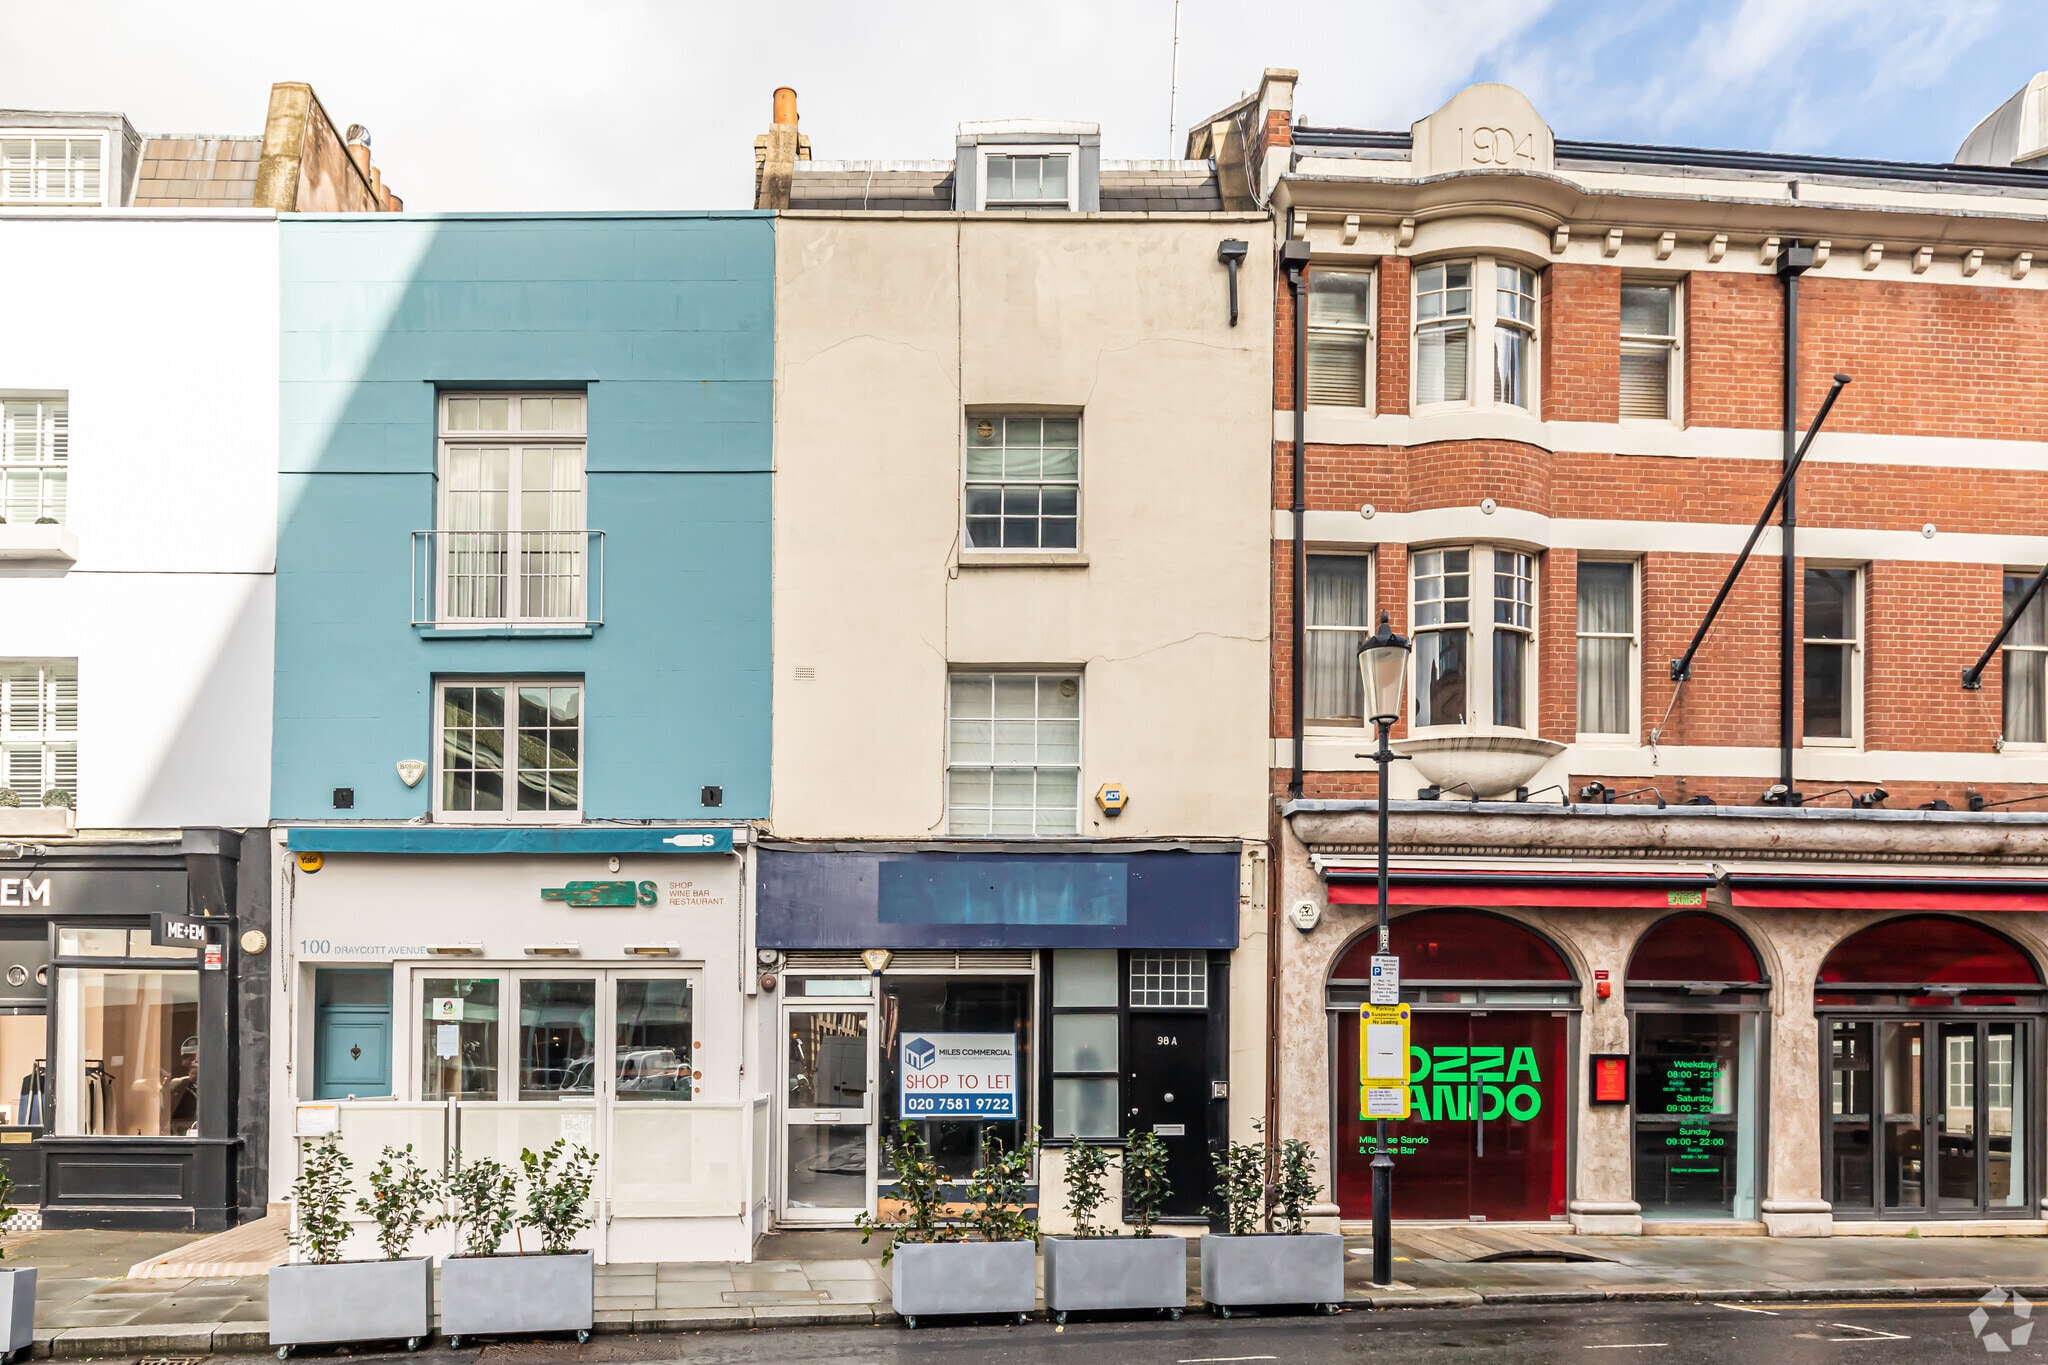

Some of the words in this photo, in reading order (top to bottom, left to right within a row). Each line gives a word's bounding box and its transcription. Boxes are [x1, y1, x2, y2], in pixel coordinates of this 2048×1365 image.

[1458, 126, 1536, 169] 1904
[1106, 791, 1120, 800] ADT
[300, 856, 318, 864] Yale
[669, 898, 725, 906] RESTAURANT
[167, 921, 205, 940] ME+EM
[300, 939, 331, 955] 100
[334, 946, 386, 955] DRAYCOTT
[388, 946, 427, 954] AVENUE
[1360, 1046, 1541, 1083] OZZA
[1673, 1060, 1717, 1070] Weekdays
[1667, 1071, 1692, 1079] 08:00
[906, 1074, 949, 1089] SHOP
[957, 1074, 979, 1089] TO
[987, 1074, 1011, 1089] LET
[1359, 1085, 1541, 1121] ANDO
[1676, 1094, 1714, 1104] Saturday
[908, 1098, 934, 1110] 020
[938, 1098, 970, 1110] 7581
[976, 1098, 1009, 1110] 9722
[1666, 1104, 1692, 1112] 09:00
[1700, 1104, 1724, 1112] 23:
[1679, 1128, 1711, 1137] Sunday
[1359, 1136, 1398, 1144] Milase
[1401, 1136, 1429, 1144] Sando
[1666, 1138, 1691, 1146] 09:00
[1699, 1138, 1724, 1146] 22:00
[1368, 1146, 1398, 1154] Cee
[1401, 1146, 1416, 1154] Bar
